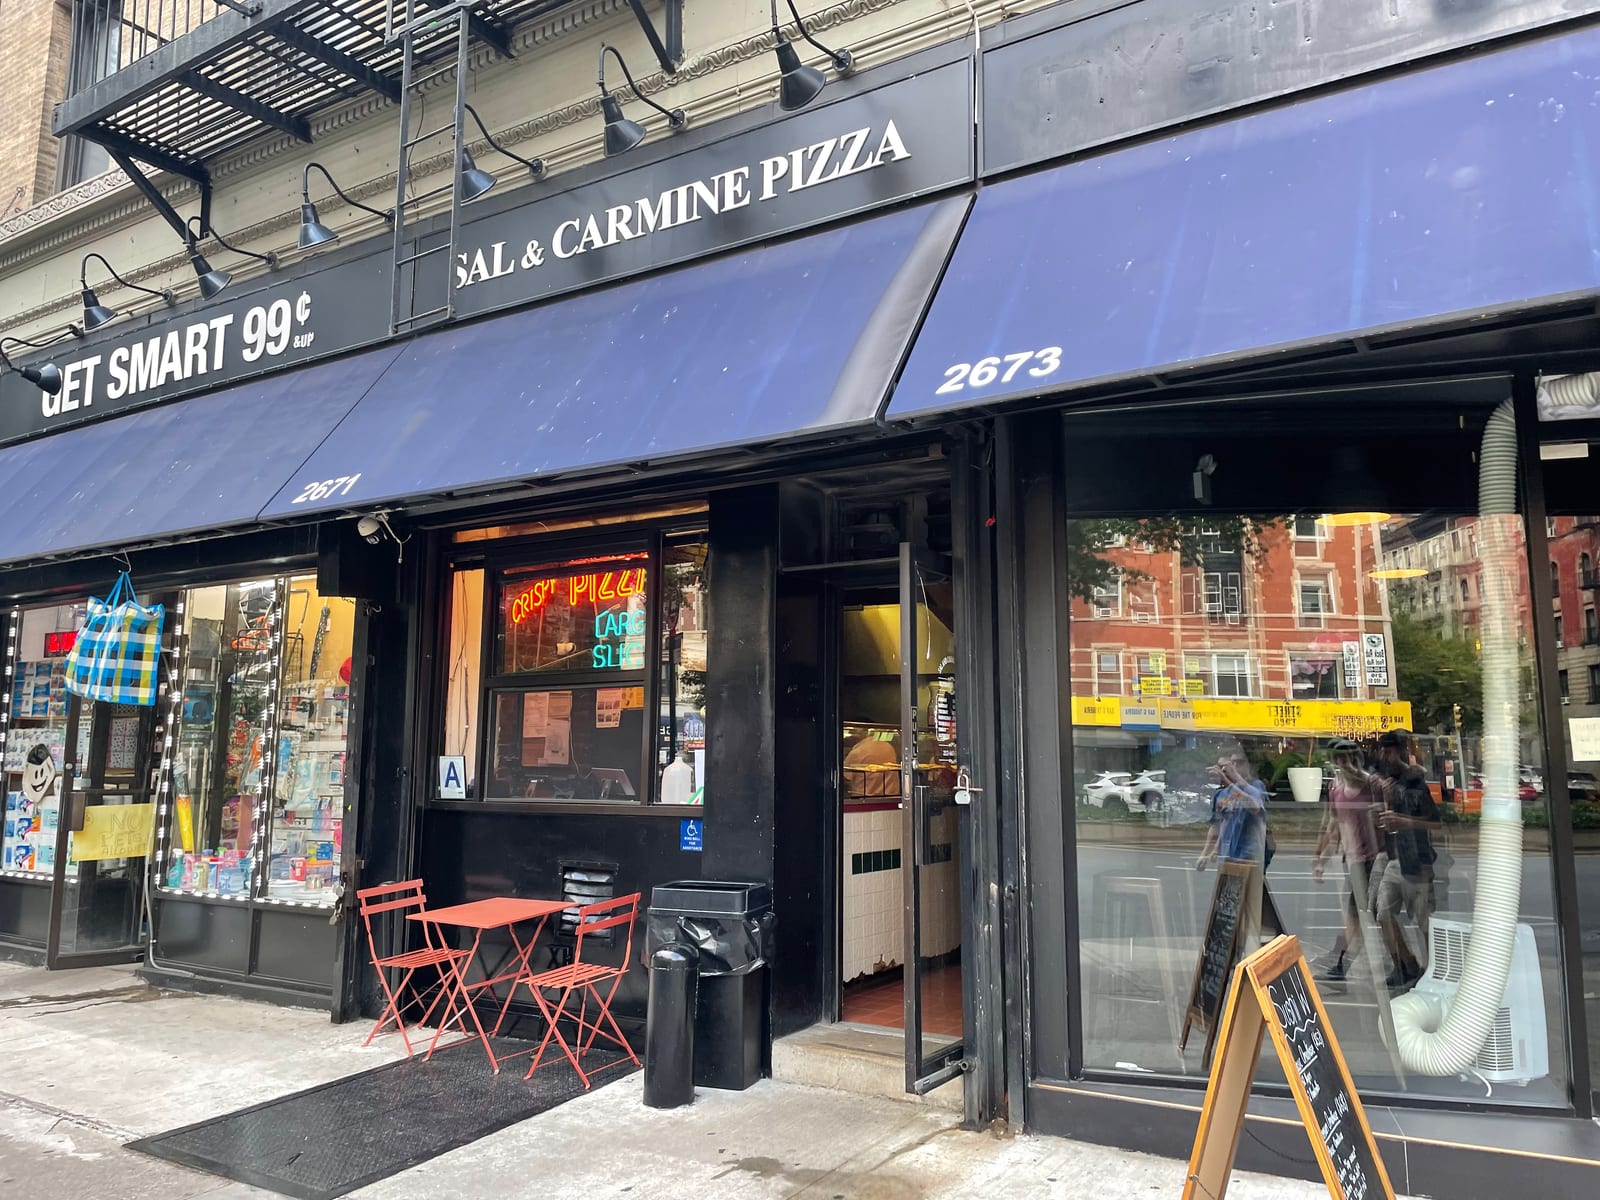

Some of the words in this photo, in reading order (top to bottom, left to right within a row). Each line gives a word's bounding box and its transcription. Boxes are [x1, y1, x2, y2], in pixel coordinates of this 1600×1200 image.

[456, 241, 515, 289] SAL
[521, 240, 545, 270] &
[552, 166, 751, 259] CARMINE
[759, 119, 911, 202] PIZZA
[293, 331, 315, 348] &UP
[106, 313, 235, 400] SMART
[935, 346, 1063, 395] 2673
[292, 473, 362, 504] 2671
[569, 567, 646, 606] PIZZ
[595, 609, 646, 639] LARG
[592, 641, 644, 668] SLIC
[444, 761, 461, 788] A
[110, 811, 144, 832] NO
[1267, 978, 1301, 1029] Sushi
[1289, 966, 1311, 1016] W
